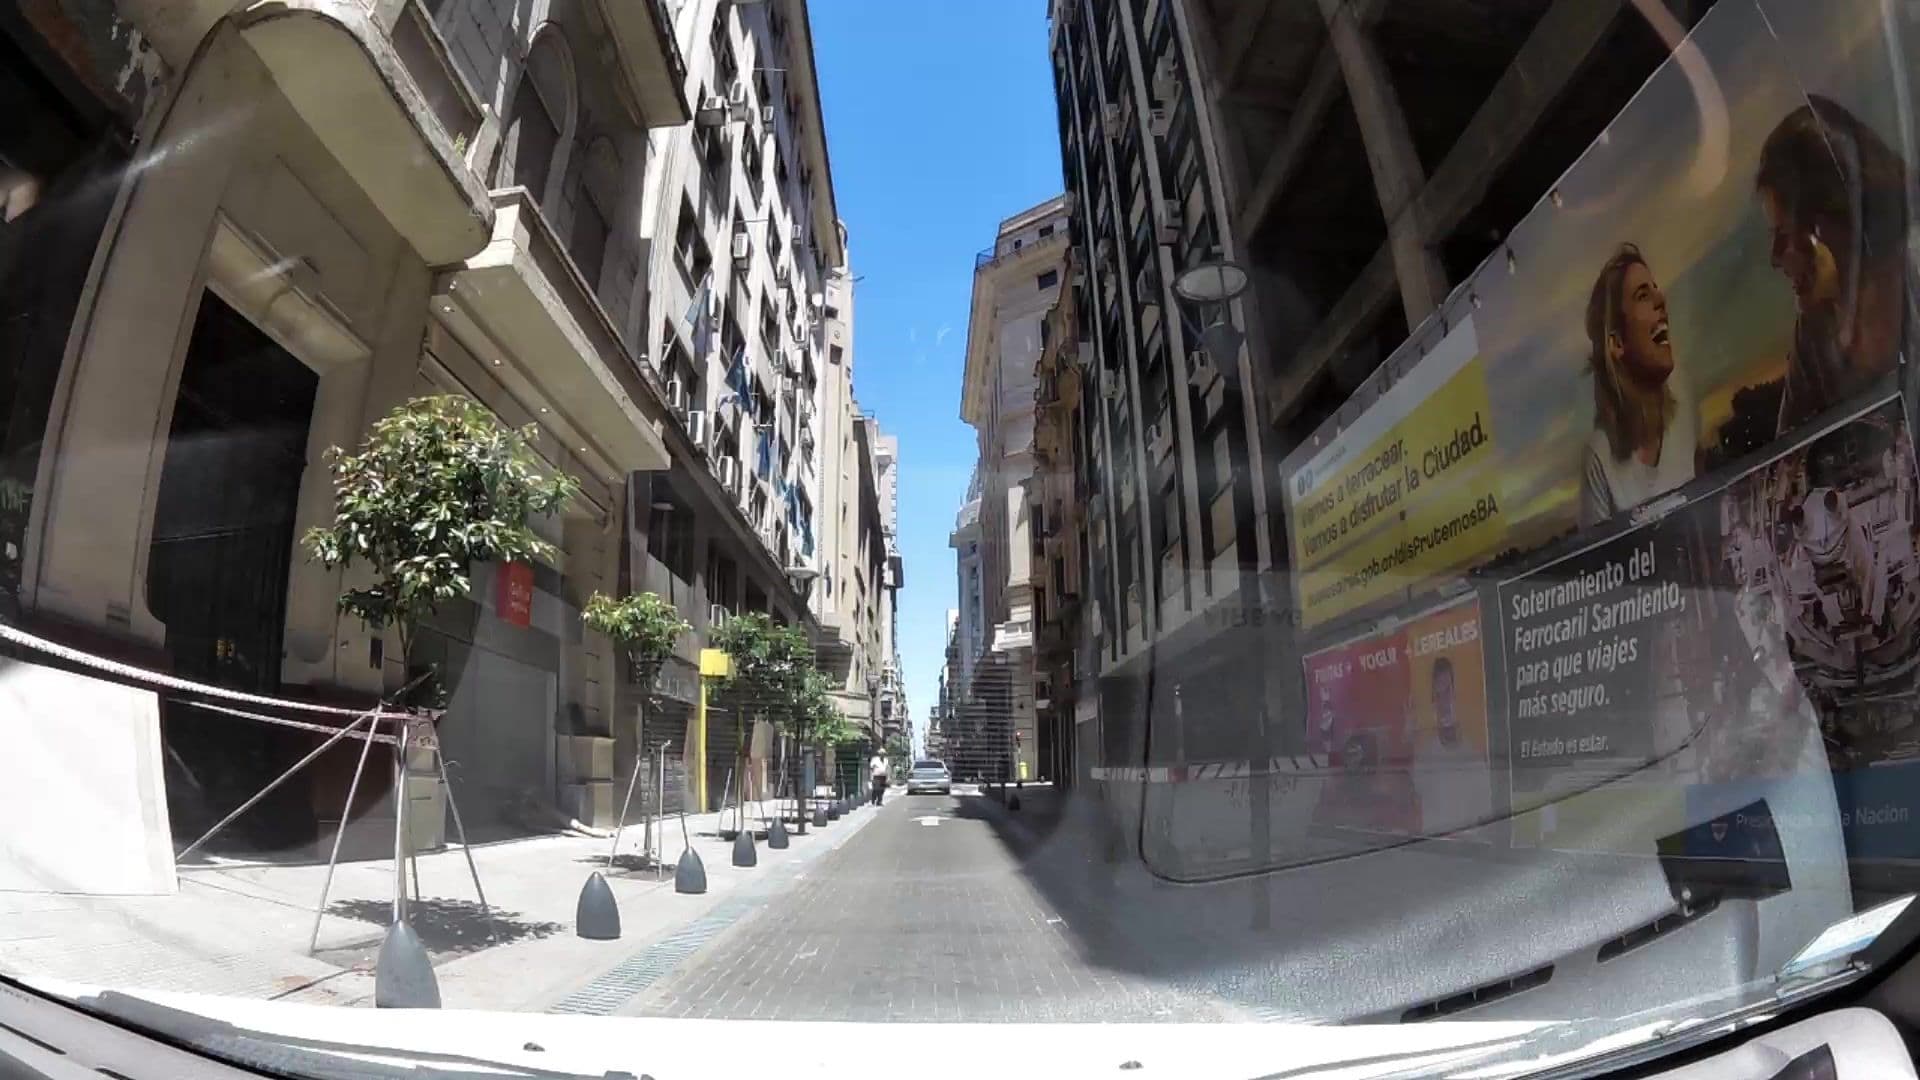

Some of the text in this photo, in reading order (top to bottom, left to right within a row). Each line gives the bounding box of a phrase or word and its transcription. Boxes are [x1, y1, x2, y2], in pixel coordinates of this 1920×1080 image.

[1350, 478, 1402, 529] disfrutar
[1405, 465, 1420, 493] la
[1423, 411, 1489, 479] Ciudad.
[1511, 540, 1656, 621] Soterramiento del
[1591, 580, 1686, 634] Sarmiento,
[1516, 635, 1639, 693] para que viajes
[1518, 683, 1611, 719] más seguro.
